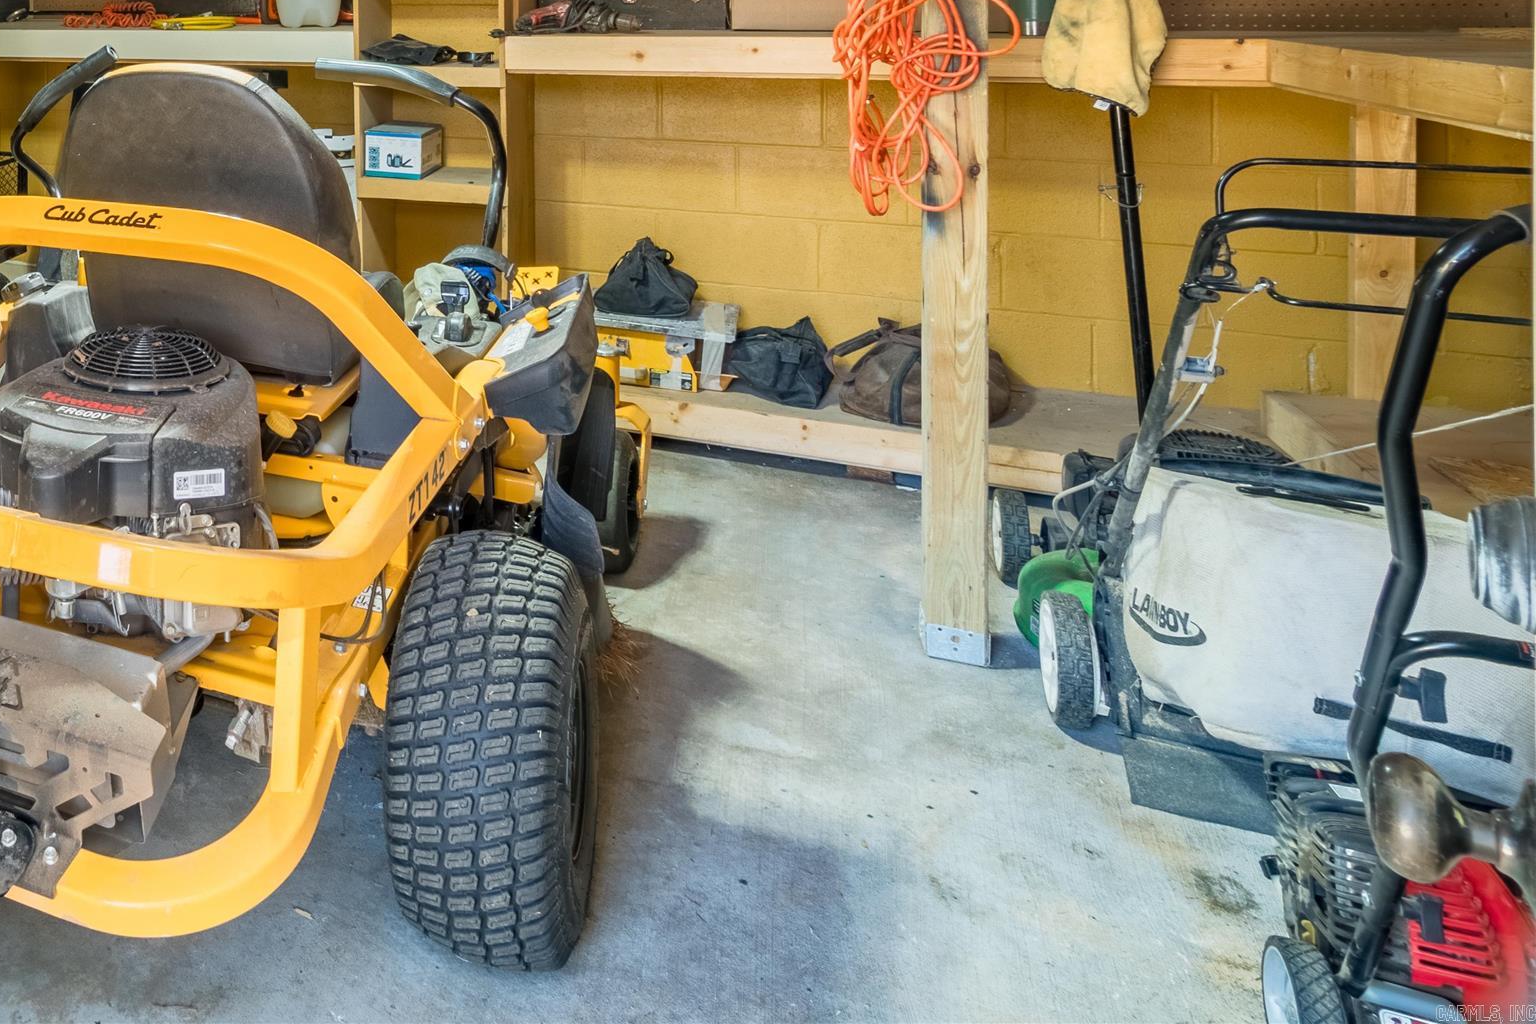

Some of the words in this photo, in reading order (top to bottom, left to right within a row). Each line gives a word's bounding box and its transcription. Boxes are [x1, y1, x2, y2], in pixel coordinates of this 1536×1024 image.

[44, 204, 87, 223] Cub
[87, 208, 164, 230] Cadet
[40, 390, 148, 416] Kawasaki
[55, 404, 113, 421] FR600V
[431, 447, 447, 488] 42
